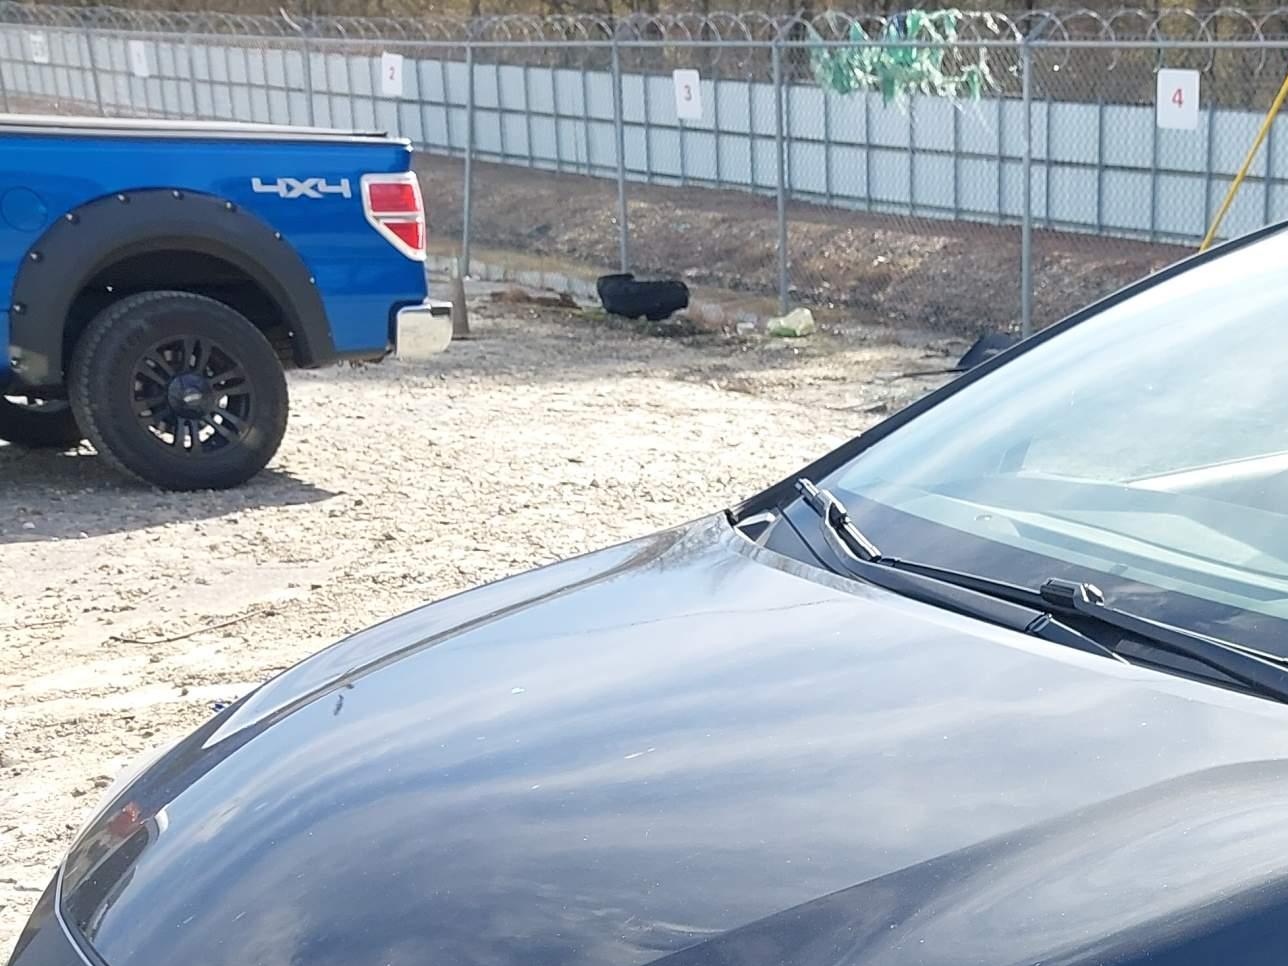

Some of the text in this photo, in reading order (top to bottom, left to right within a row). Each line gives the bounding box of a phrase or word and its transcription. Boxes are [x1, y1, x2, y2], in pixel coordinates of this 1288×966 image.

[388, 65, 396, 81] 2
[683, 84, 693, 102] 3
[1171, 88, 1185, 109] 4
